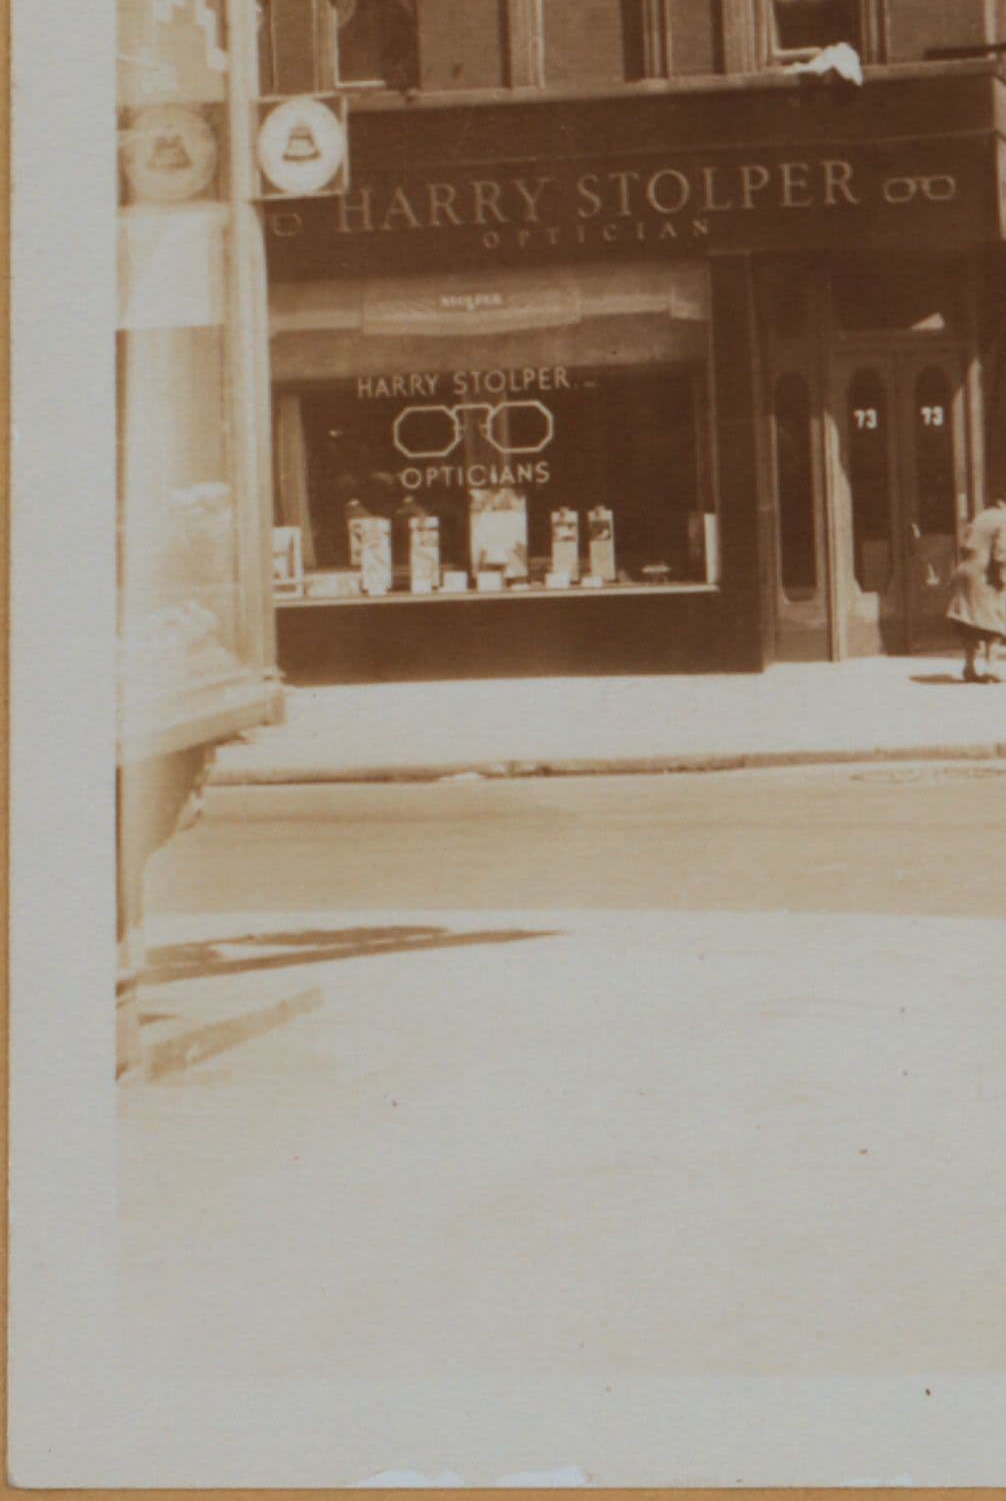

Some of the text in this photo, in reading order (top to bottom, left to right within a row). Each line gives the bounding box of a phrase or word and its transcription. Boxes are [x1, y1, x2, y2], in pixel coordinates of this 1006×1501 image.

[336, 159, 861, 233] HARRY STOLPER
[484, 219, 709, 250] OPTICIAN
[357, 366, 570, 398] HARRY STOLPER
[854, 408, 878, 429] 73
[920, 405, 944, 427] 73
[402, 460, 550, 490] OPTICIANS
